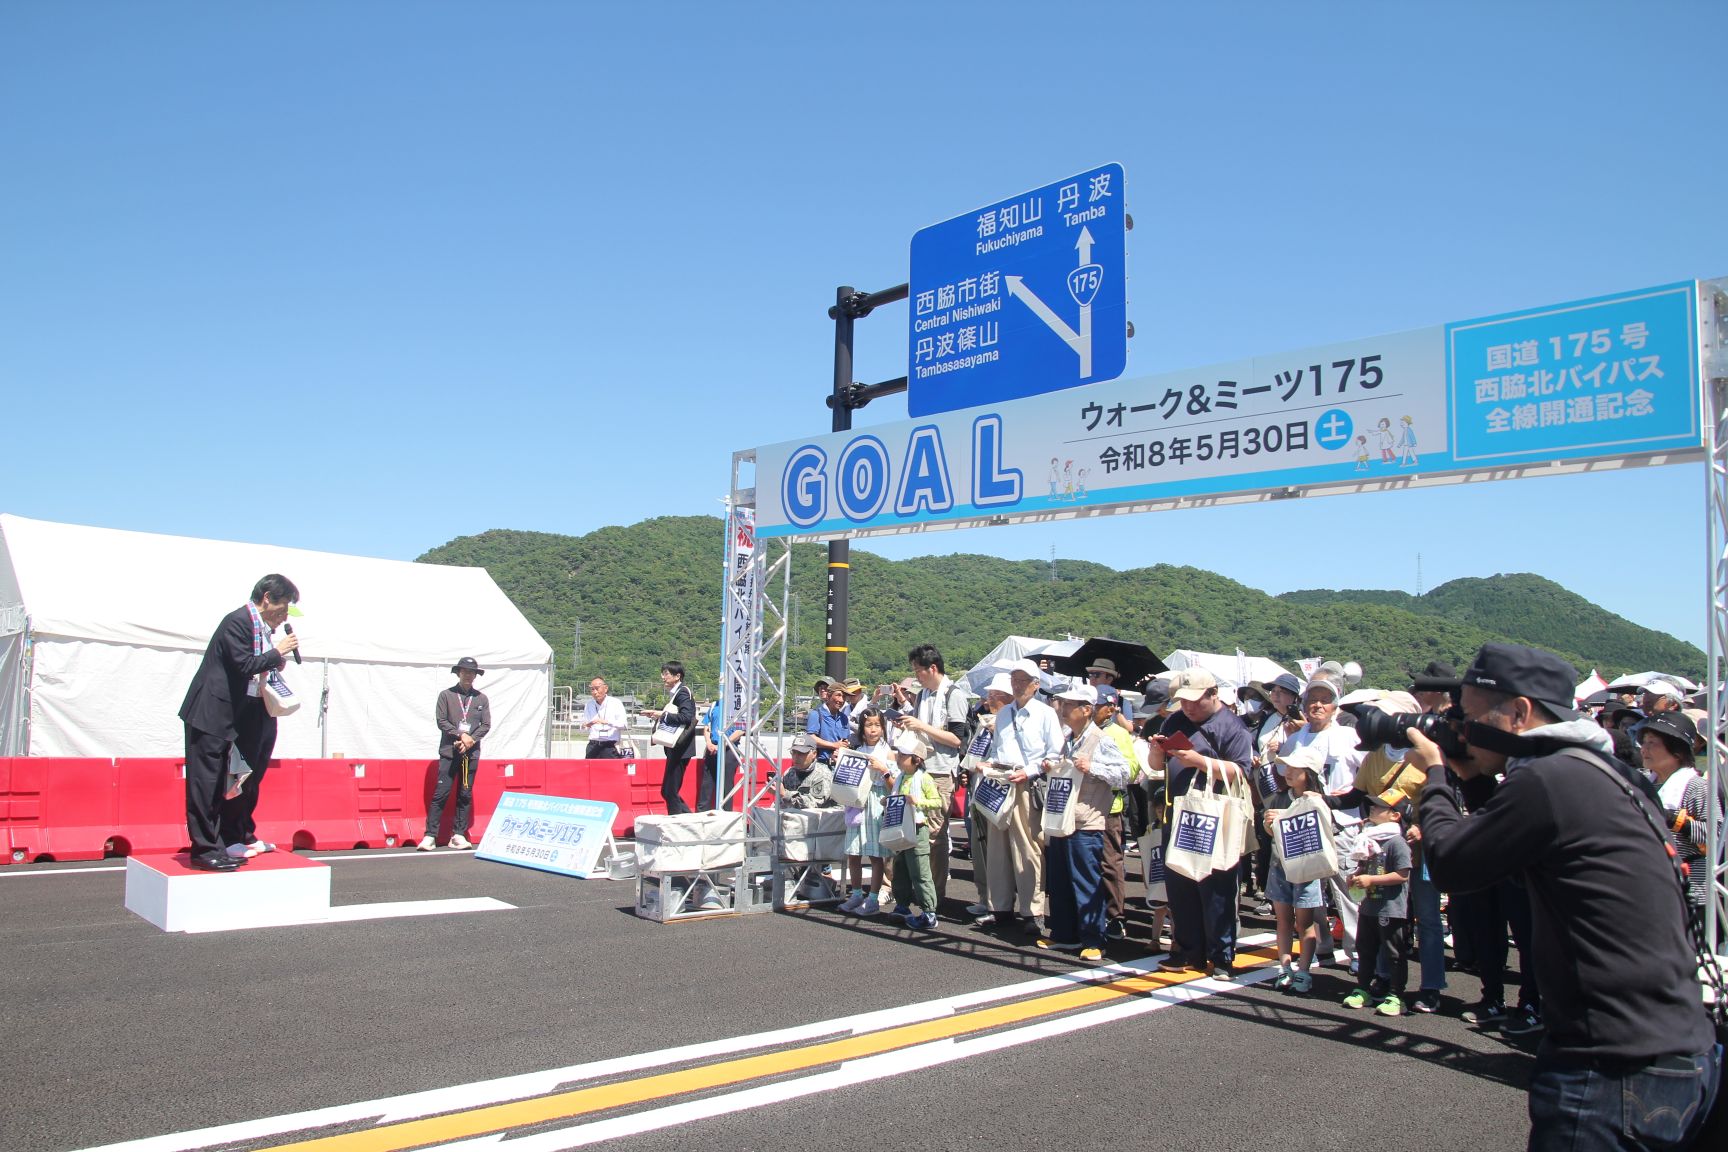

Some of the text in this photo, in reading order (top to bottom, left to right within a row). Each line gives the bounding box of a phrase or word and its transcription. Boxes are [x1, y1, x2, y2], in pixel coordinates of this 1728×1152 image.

[1057, 173, 1112, 213] 丹波
[976, 197, 1042, 239] 福知山
[1064, 204, 1106, 228] Tamba
[976, 225, 1043, 256] Fukuchiyama
[916, 270, 1000, 316] 西脇市街
[1072, 271, 1098, 294] 175
[915, 297, 1001, 333] Central Nishiwaki
[915, 321, 999, 364] 丹波篠山
[1486, 322, 1649, 371] 国道175号
[915, 350, 999, 379] Tambasasayama
[1474, 355, 1665, 404] 西脇北バイパス
[1081, 354, 1384, 432] ウォーク&ミーツ175
[1485, 388, 1655, 433] 全線開通記念
[1098, 413, 1348, 475] 令和8年5月30日 土
[781, 413, 1023, 529] GOAL
[840, 755, 867, 769] R175
[886, 795, 905, 809] 175
[1050, 778, 1071, 792] R175
[1181, 811, 1216, 831] R175
[1281, 812, 1316, 834] R175
